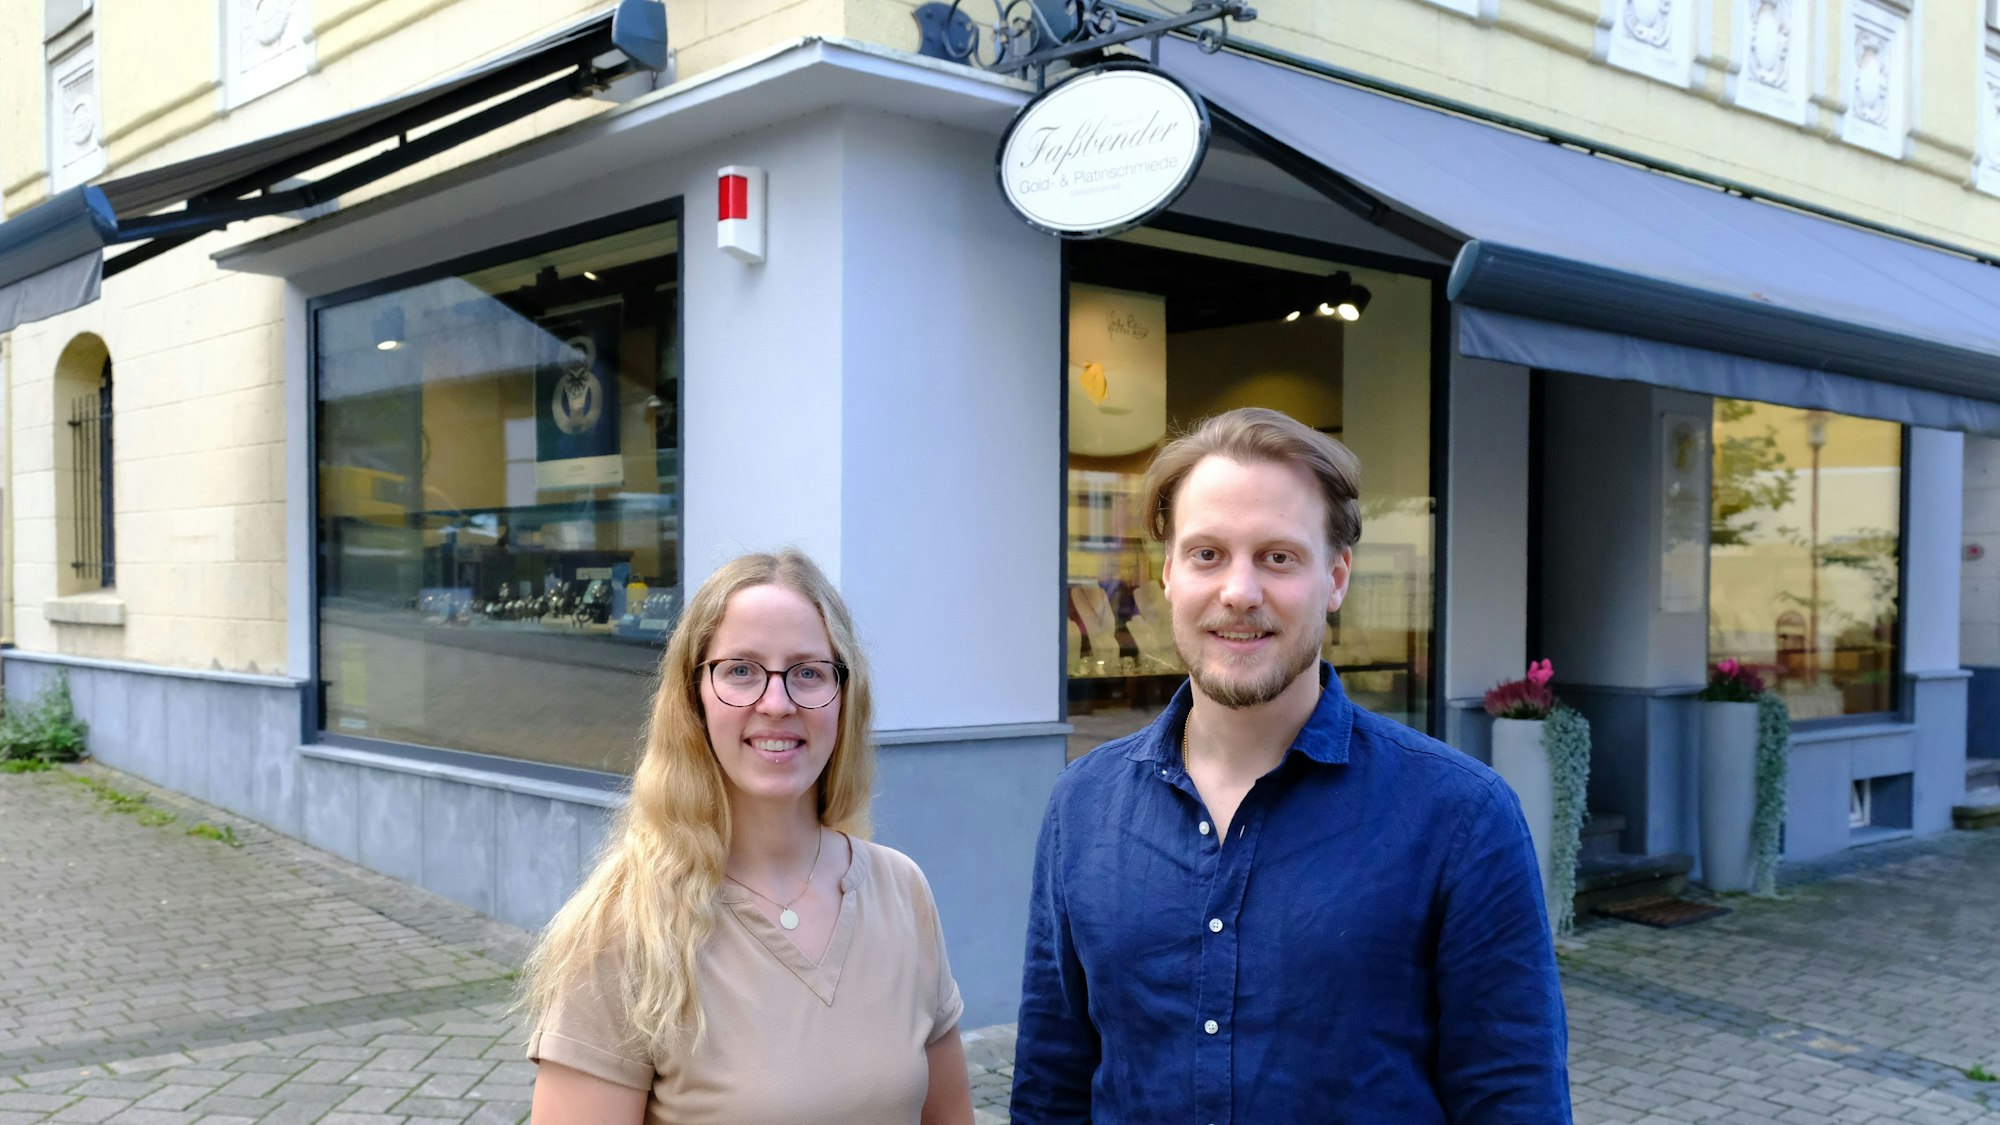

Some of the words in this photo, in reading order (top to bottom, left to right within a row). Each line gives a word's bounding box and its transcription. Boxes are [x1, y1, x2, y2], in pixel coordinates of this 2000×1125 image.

[1020, 111, 1178, 175] Faßbender
[1020, 178, 1055, 194] Gold-
[1059, 174, 1069, 187] &
[1074, 155, 1178, 184] Platinschmiede
